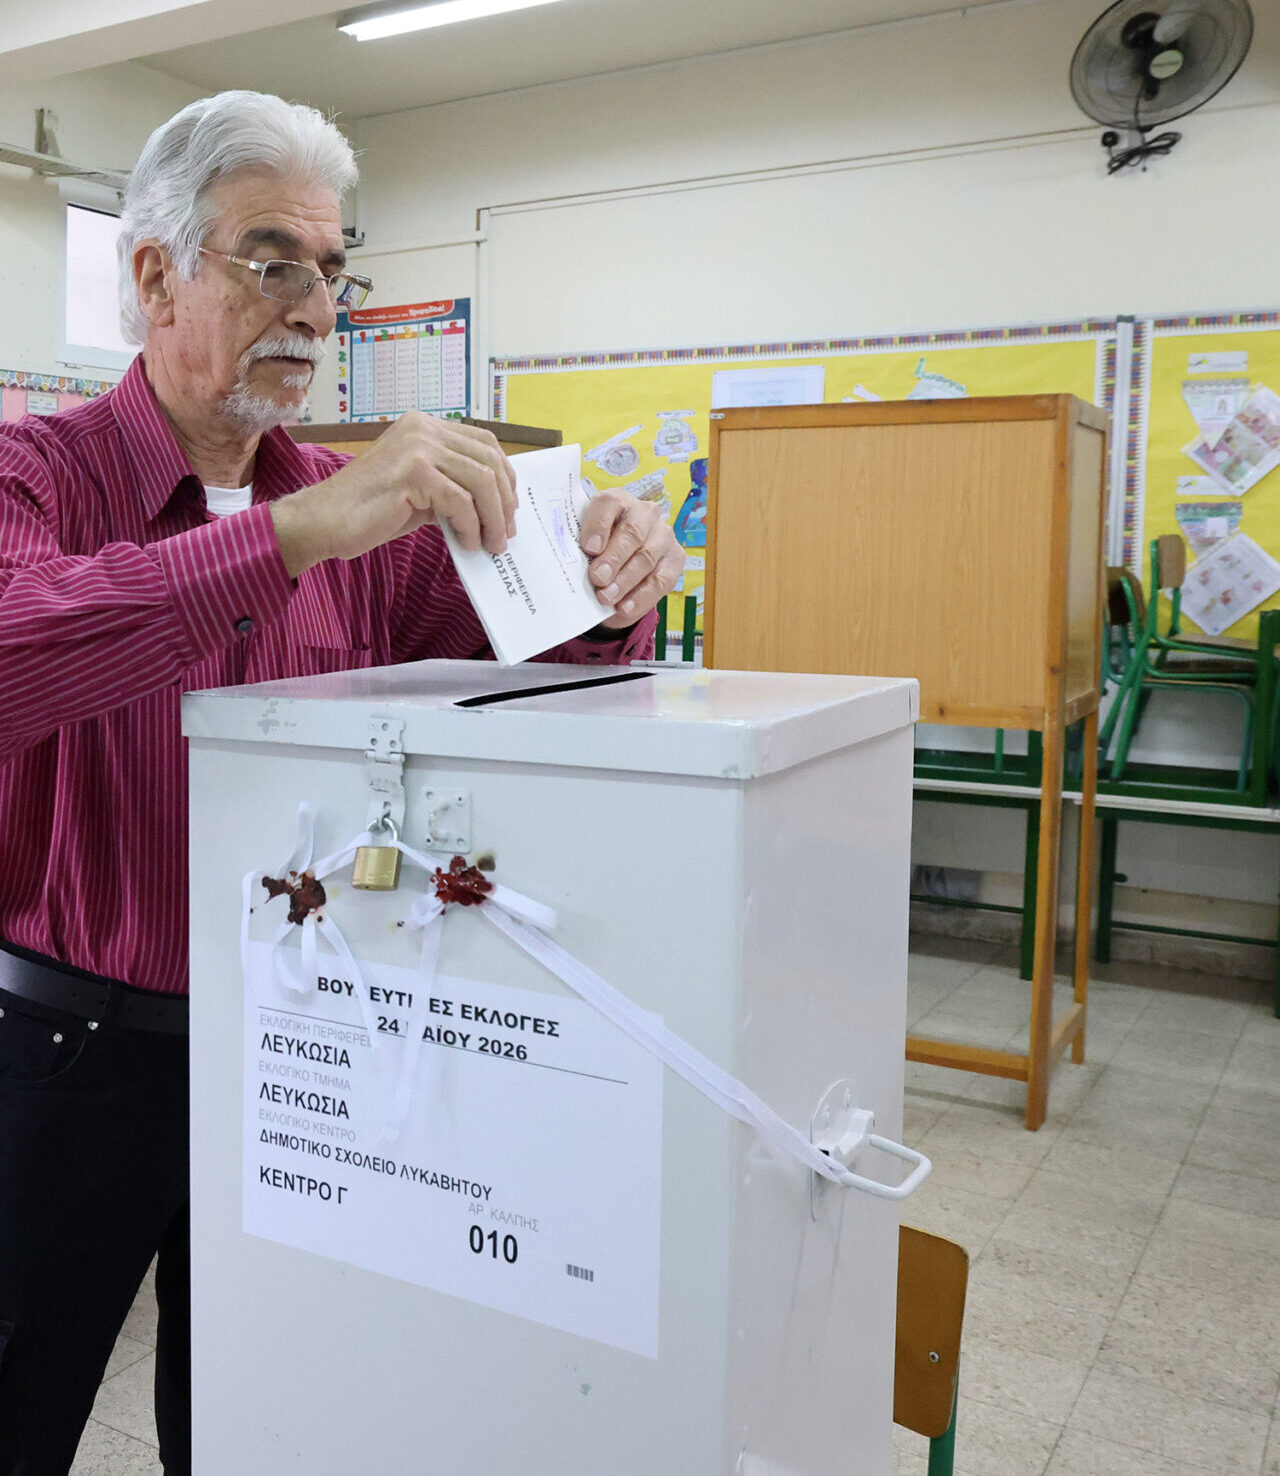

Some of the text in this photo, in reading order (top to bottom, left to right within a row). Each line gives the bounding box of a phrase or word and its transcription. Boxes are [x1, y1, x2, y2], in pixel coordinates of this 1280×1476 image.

[504, 552, 537, 615] ΠΕΡΙΦΕΡΕΙΑ
[317, 976, 560, 1038] ΒΟΥΕΥΤΙΕΣ ΕΚΛΟΓΕΣ
[259, 1013, 372, 1048] ΕΚΛΟΓΙΚΗ ΠΕΡΙΦΕΡΕΙ
[377, 1015, 528, 1061] 24 ΑΪΟΥ 2026
[260, 1032, 351, 1069] ΛΕΥΚΩΣΙΑ
[258, 1060, 352, 1092] ΕΚΛΟΓΙΚΟ ΤΜΗΜΑ
[259, 1082, 350, 1120] ΛΕΥΚΩΣΙΑ
[258, 1108, 357, 1143] ΕΚΛΟΓΙΚΟ ΚΕΝΤΡΟ
[260, 1128, 493, 1201] ΔΗΜΟΤΙΚΟ ΣΧΟΛΕΙΟ ΛΥΚΑΒΗΤΟΥ
[260, 1165, 349, 1205] ΚΕΝΤΡΟ Γ
[490, 1207, 540, 1233] ΚΑΛΠΗΣ
[469, 1224, 519, 1264] 010
